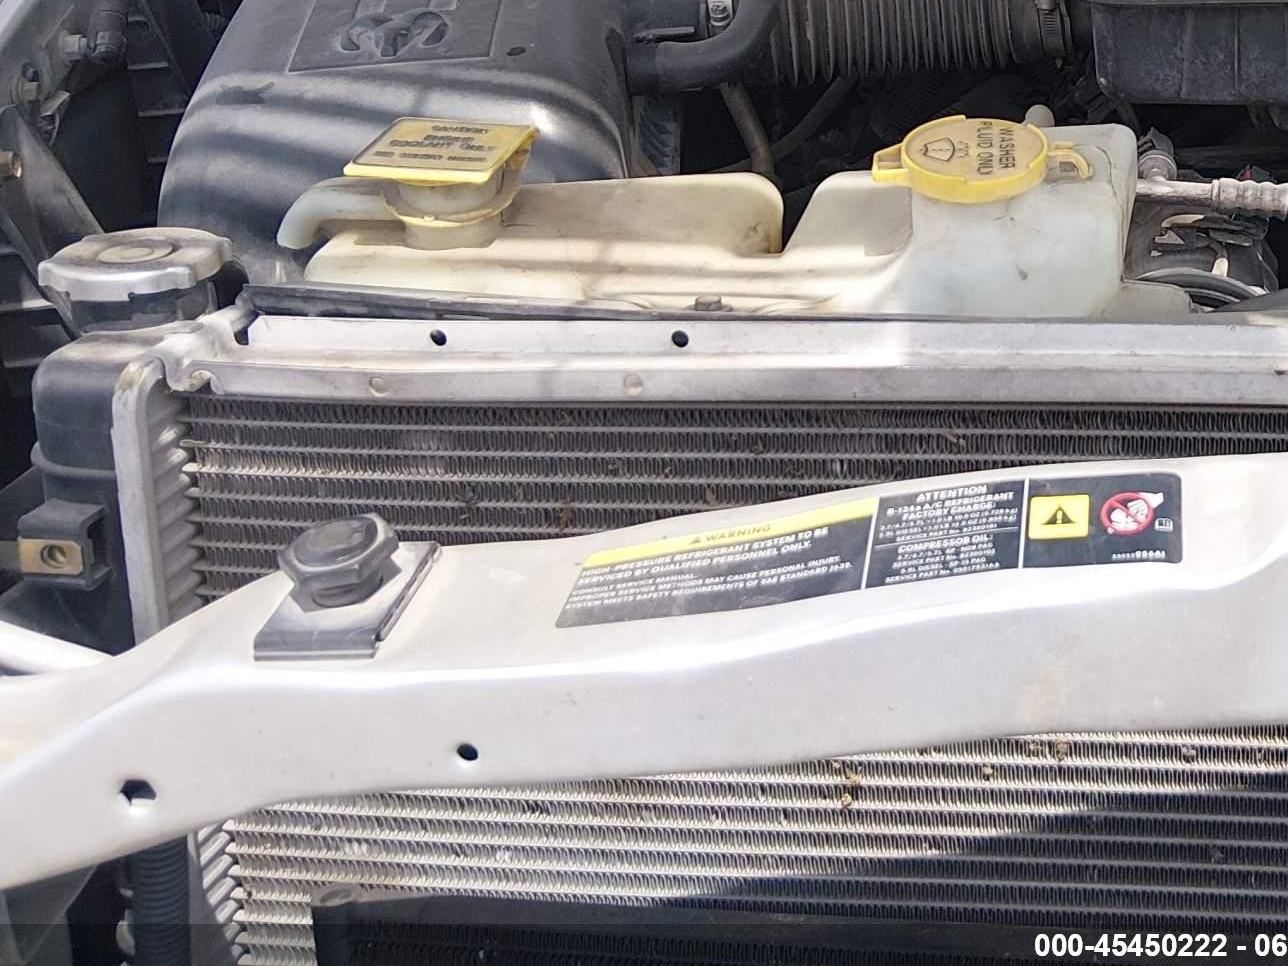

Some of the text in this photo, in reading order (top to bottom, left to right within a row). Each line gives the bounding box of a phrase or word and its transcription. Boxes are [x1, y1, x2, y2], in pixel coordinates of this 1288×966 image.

[976, 121, 993, 175] FLUID ONLY
[999, 125, 1016, 169] WASHER
[916, 485, 988, 503] ATTENTION
[886, 491, 1015, 518] R-134a A/C REFRIGERANT
[901, 508, 949, 521] FACTORY
[706, 524, 771, 541] WARNING
[896, 532, 928, 542] SERVICE
[929, 529, 948, 537] PART
[673, 543, 752, 561] REFRIGERANT
[751, 535, 797, 549] SYSTEM
[797, 531, 812, 540] TO
[813, 527, 830, 538] BE
[898, 537, 971, 554] COMPRESSOR
[577, 540, 813, 584] SERVICED BY QUALIFIED PERSONNEL ONLY.
[892, 558, 924, 570] SERVICE
[925, 555, 945, 564] PART
[615, 579, 655, 589] SERVICE
[617, 586, 656, 595] SERVICE
[657, 579, 704, 590] METHODS
[704, 576, 726, 585] MAY
[727, 571, 758, 581] CAUSE
[758, 563, 806, 575] PERSONAL
[807, 555, 842, 567] INJURY.
[884, 573, 917, 585] SERVICE
[919, 570, 938, 579] PART
[602, 595, 634, 605] MEETS
[635, 590, 670, 601] SAFETY
[671, 581, 745, 595] REQUIREMENTS
[760, 576, 779, 586] SAE
[780, 566, 828, 581] STANDARD
